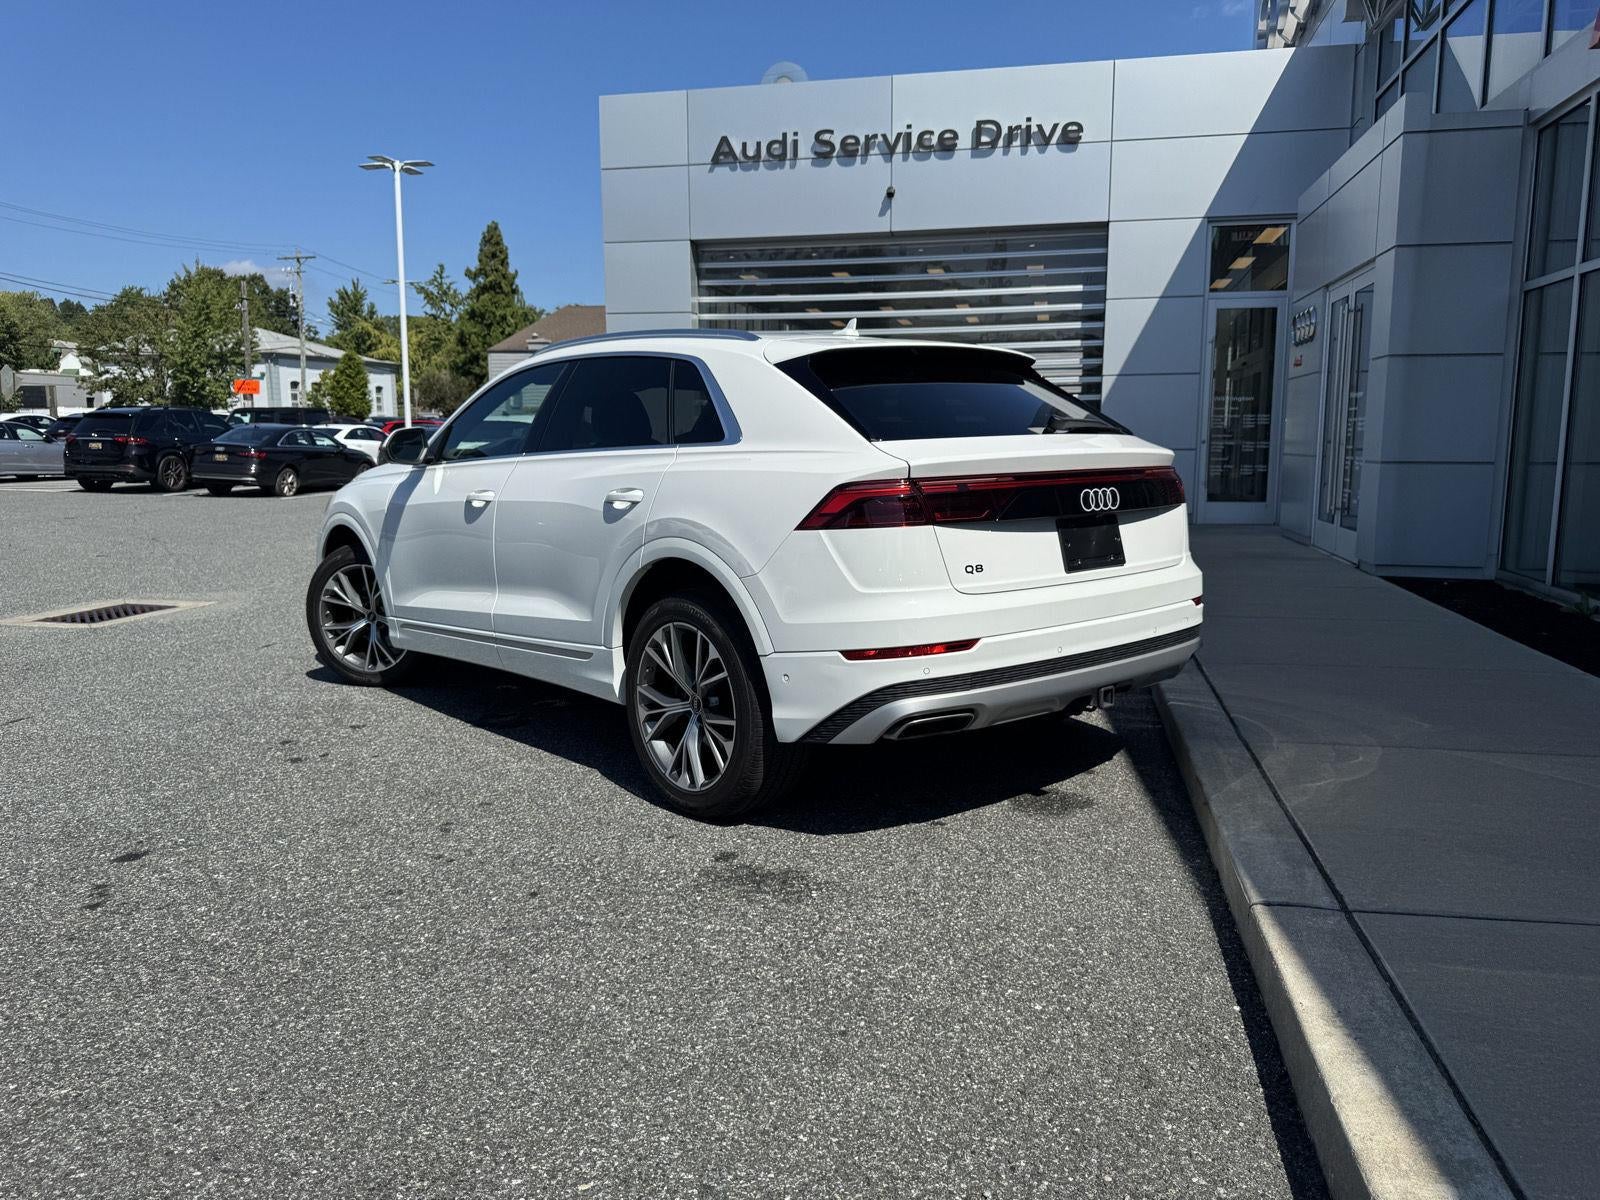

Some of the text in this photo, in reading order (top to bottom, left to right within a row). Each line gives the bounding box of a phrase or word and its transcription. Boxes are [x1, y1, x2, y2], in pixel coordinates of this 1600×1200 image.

[710, 116, 1084, 164] Audi Service Drive
[965, 564, 984, 575] Q8
